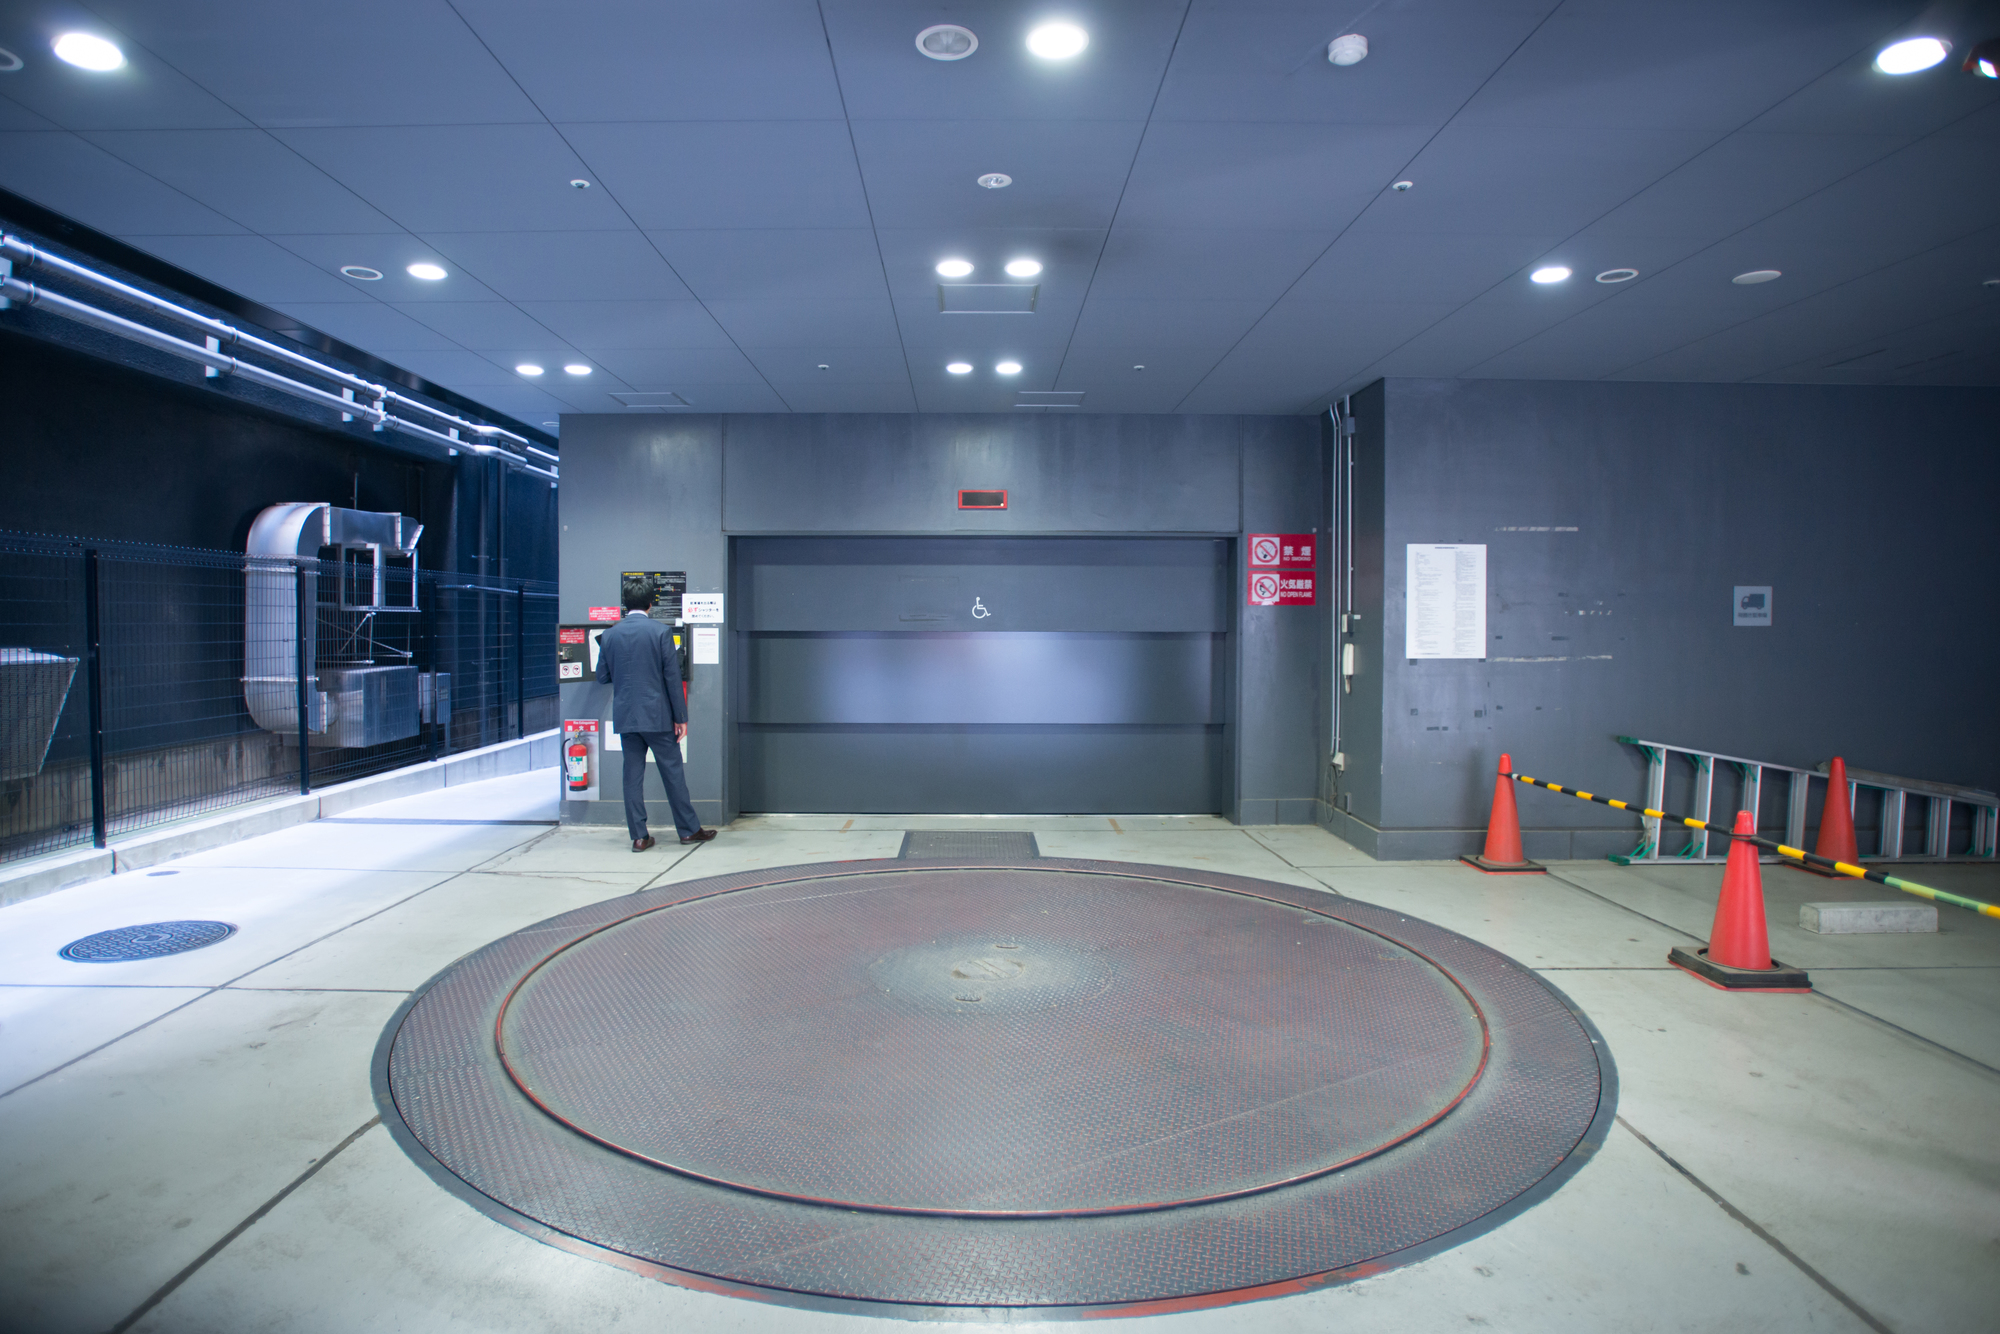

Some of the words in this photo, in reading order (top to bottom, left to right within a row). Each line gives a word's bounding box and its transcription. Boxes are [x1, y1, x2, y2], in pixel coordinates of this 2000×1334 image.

[1283, 546, 1311, 556] 禁煙
[1280, 579, 1312, 589] 火気厳禁
